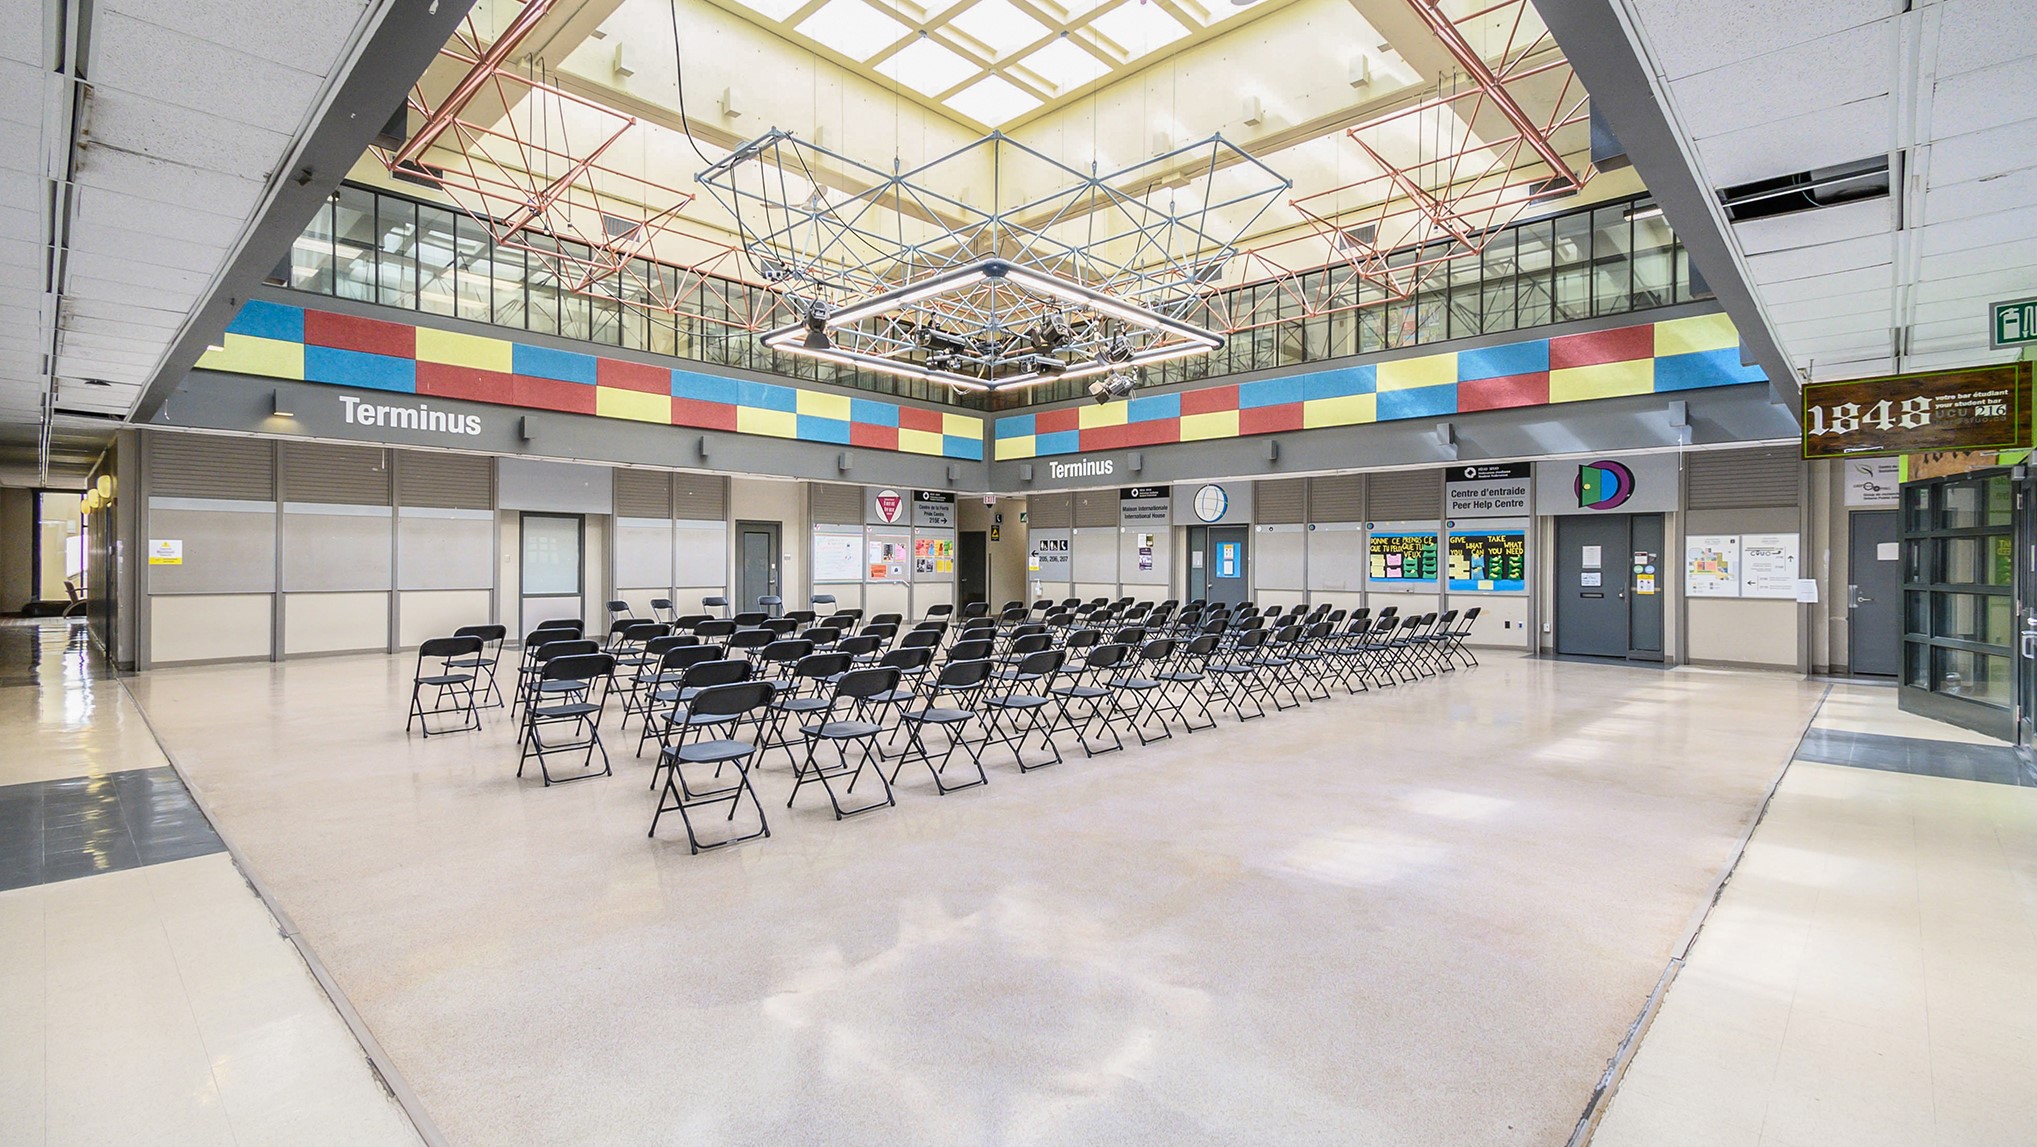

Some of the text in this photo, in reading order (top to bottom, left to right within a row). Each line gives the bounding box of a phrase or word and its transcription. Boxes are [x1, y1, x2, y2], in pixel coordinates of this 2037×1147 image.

[1973, 389, 2009, 398] étudiant
[1935, 402, 1953, 410] your
[1954, 399, 1986, 407] student
[339, 395, 482, 435] Terminus
[1807, 395, 1933, 436] 1848
[1935, 405, 2007, 418] UCU 216
[1049, 458, 1113, 479] Terminus
[1451, 486, 1526, 498] Centre d'entraide
[1452, 499, 1524, 510] Peer Help Centre
[1391, 537, 1400, 545] CE
[1423, 536, 1433, 545] CE
[1487, 535, 1506, 543] TAKE
[1402, 543, 1423, 551] QUE TU
[1503, 541, 1523, 549] WHAT
